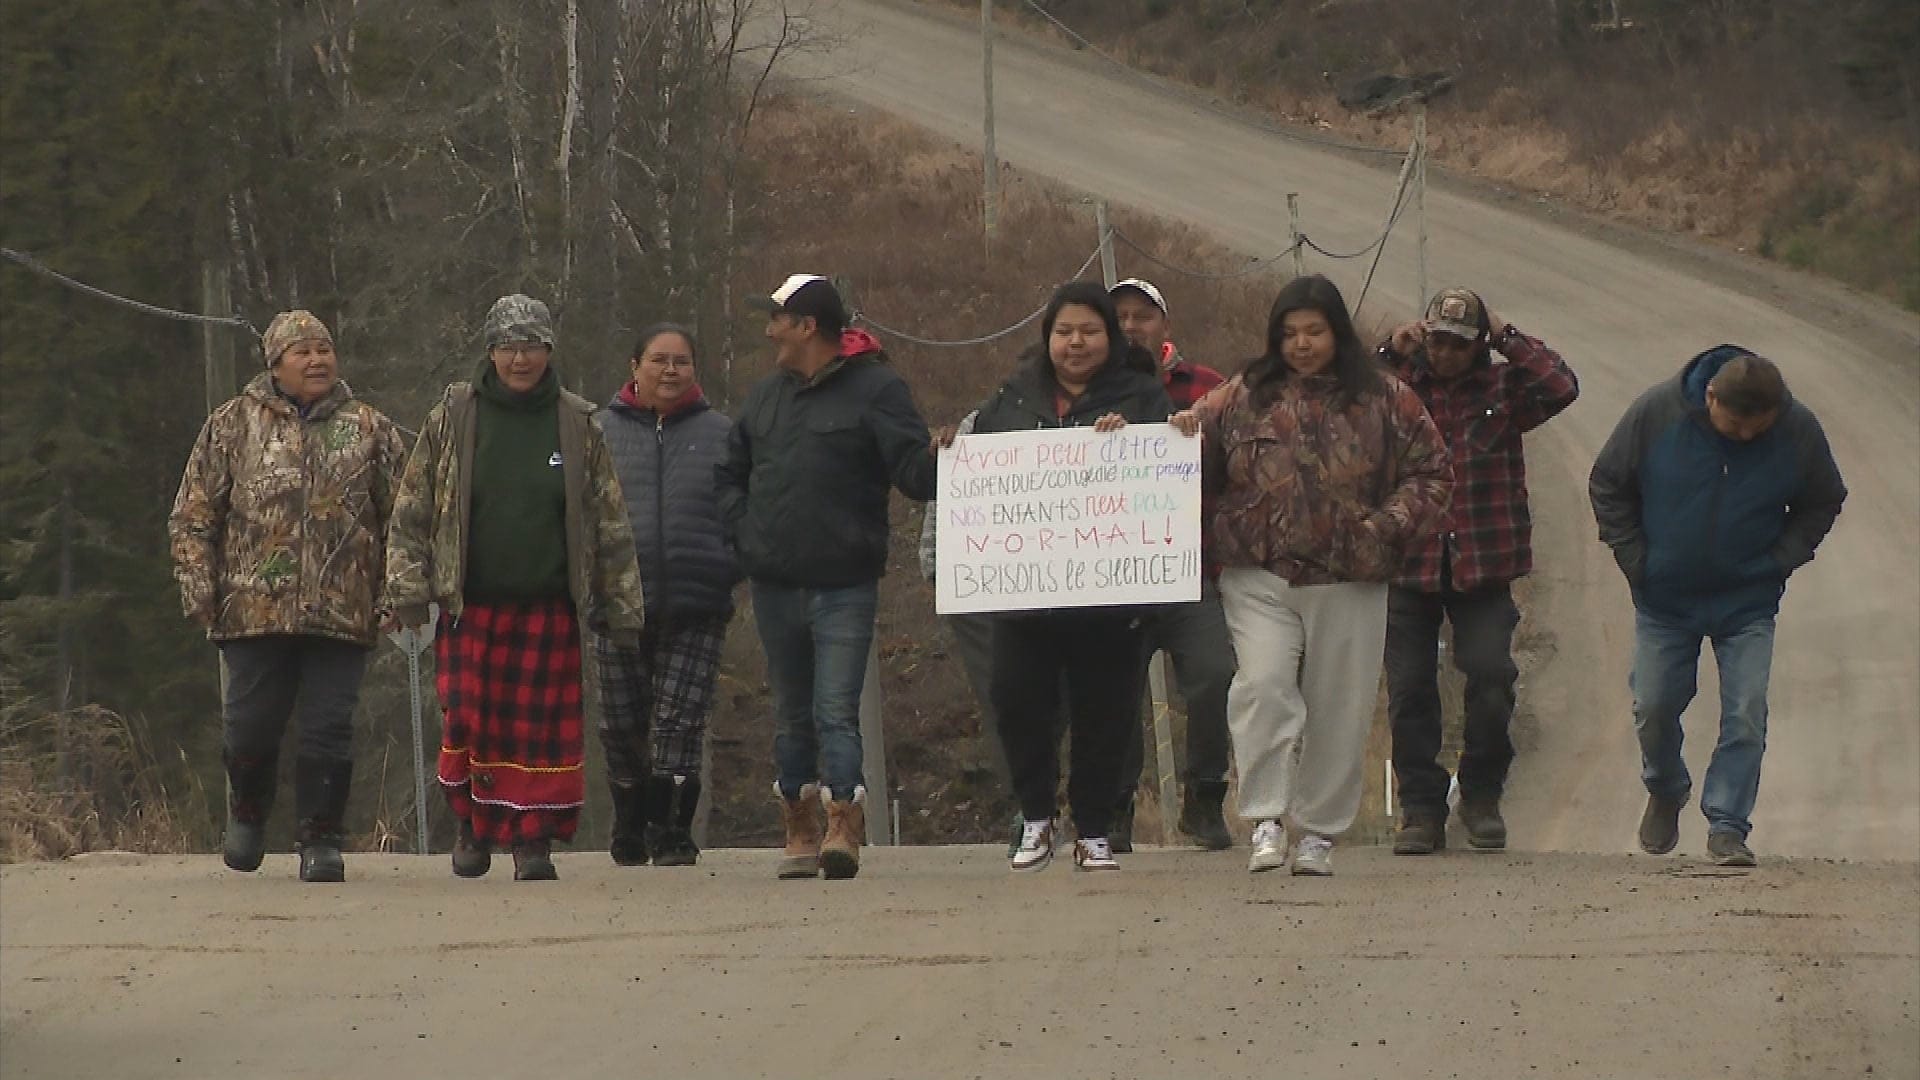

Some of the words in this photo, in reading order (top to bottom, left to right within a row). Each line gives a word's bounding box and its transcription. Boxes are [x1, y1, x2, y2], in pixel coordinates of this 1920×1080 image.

[951, 439, 1019, 474] Avoir
[1037, 440, 1091, 468] peur
[1122, 464, 1154, 482] pour
[1066, 557, 1085, 590] le
